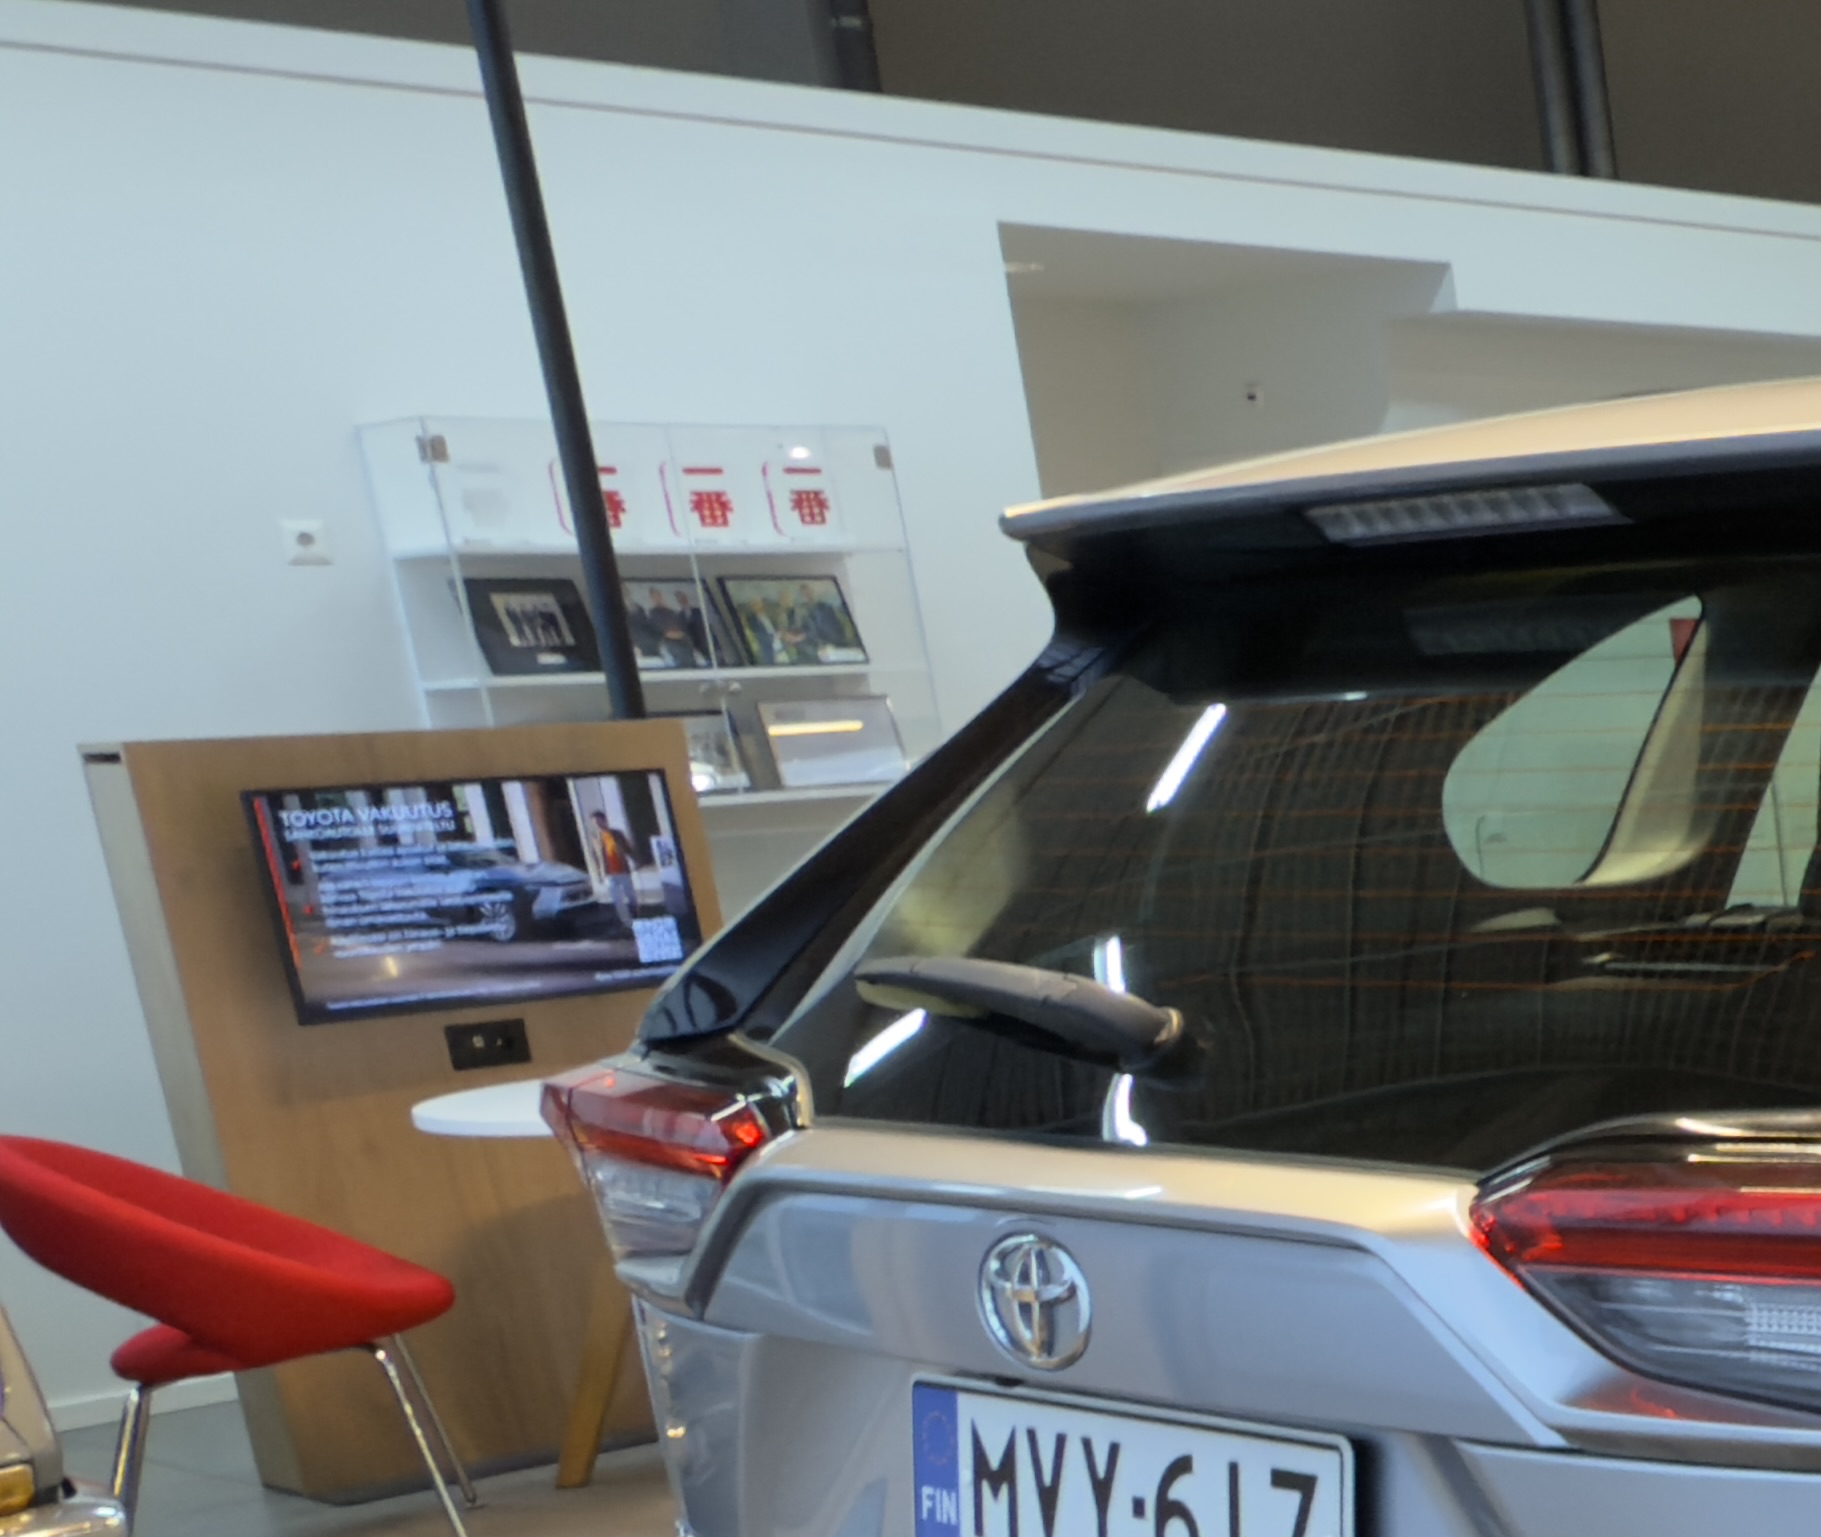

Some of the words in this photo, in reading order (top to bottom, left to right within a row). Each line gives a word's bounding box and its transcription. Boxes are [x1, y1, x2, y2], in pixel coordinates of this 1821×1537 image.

[279, 806, 355, 828] TOYOTA
[356, 802, 454, 824] VAKUUTUS
[920, 1485, 958, 1526] FIN
